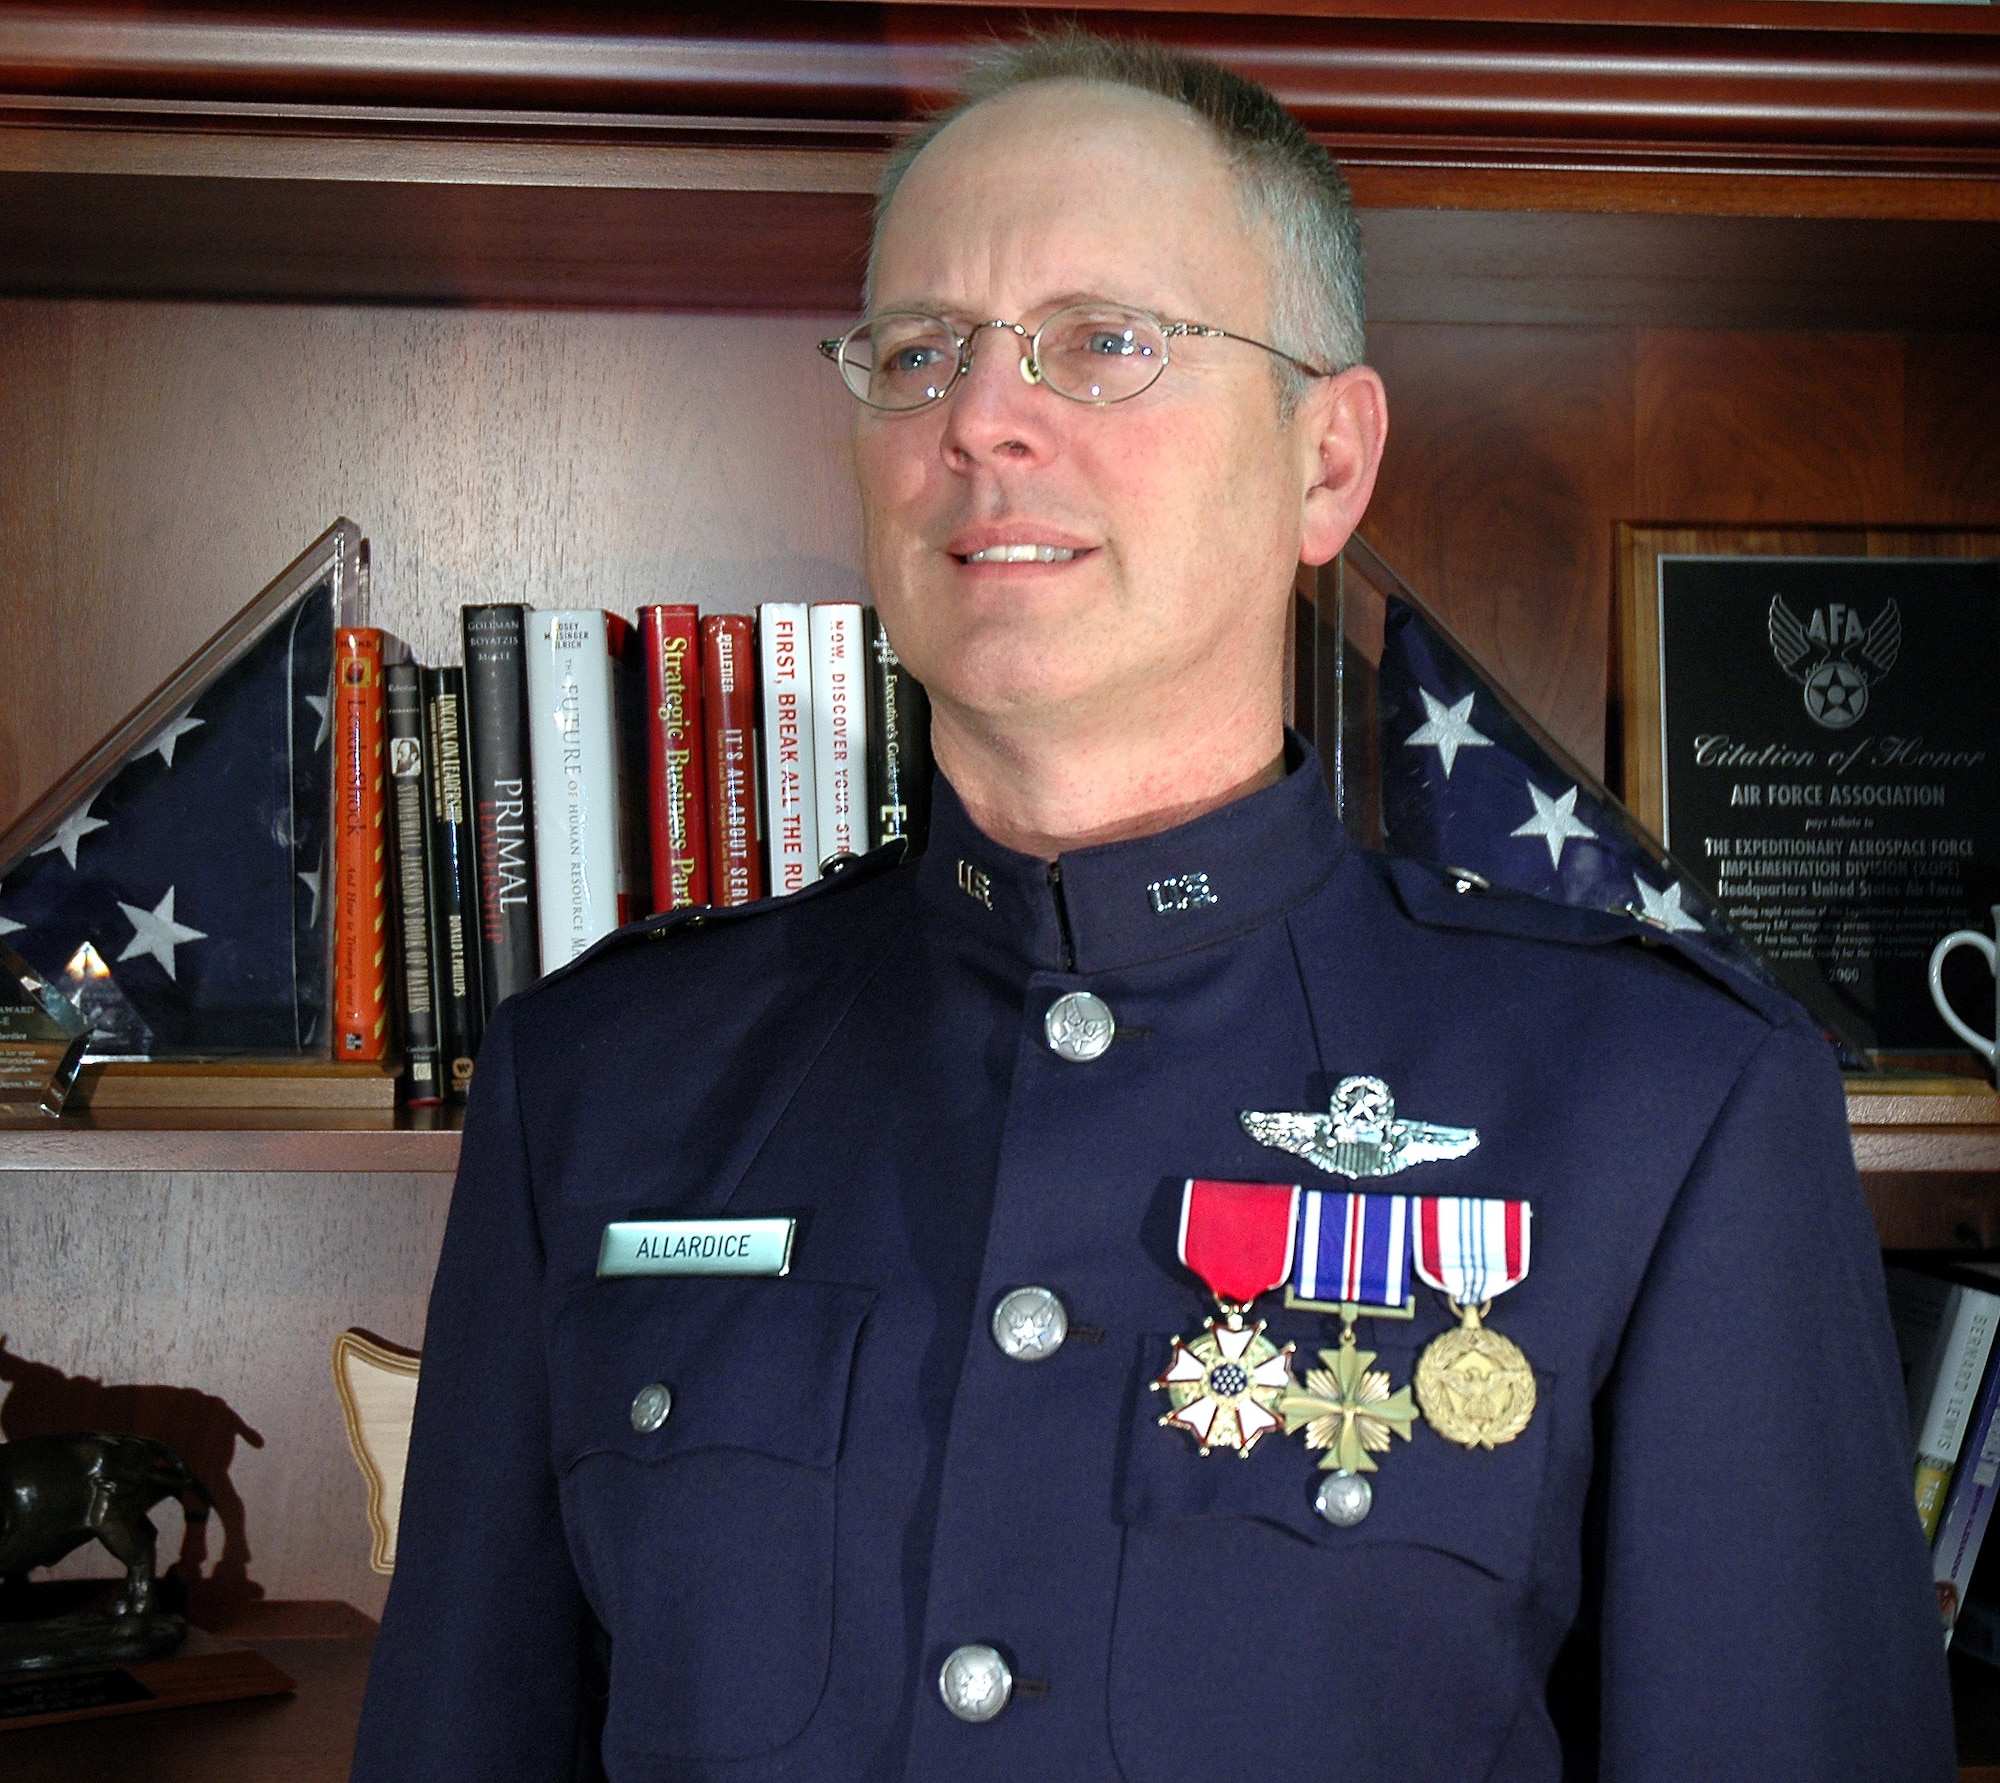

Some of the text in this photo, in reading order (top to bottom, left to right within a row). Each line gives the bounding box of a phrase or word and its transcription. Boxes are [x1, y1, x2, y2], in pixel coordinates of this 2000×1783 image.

[556, 623, 579, 631] OSEY
[830, 620, 845, 664] NOW,
[1808, 603, 1864, 645] AFA
[774, 621, 795, 684] FIRST,
[658, 637, 691, 740] Strategic
[562, 685, 582, 774] FUTURE
[778, 693, 799, 763] BREAK
[832, 673, 848, 761] DISCOVER
[438, 694, 464, 824] LINCOLN ON LEADERSHIP
[726, 729, 744, 760] IT'S
[1694, 734, 1986, 776] Citation of Honor
[348, 700, 368, 837] LeaderShock
[568, 780, 578, 798] OF
[728, 770, 744, 797] ALL
[781, 770, 800, 808] ALL
[666, 748, 692, 850] Business
[834, 768, 849, 815] YOUR
[1730, 784, 1946, 807] AIR FORCE ASSOCIATION
[494, 778, 528, 913] PRIMAL
[568, 805, 581, 856] HUMAN
[729, 806, 747, 858] ABOUT
[783, 813, 802, 854] THE
[1704, 837, 1974, 857] THE EXPEDITIONARY AEROSPACE FORCE
[479, 802, 505, 945] LEADERSHIP
[1718, 879, 1807, 900] Headquarters
[1811, 880, 1855, 898] United
[1859, 880, 1900, 898] States
[1929, 881, 1964, 898] Force
[1720, 859, 1841, 878] IMPLEMENTATION
[1846, 860, 1908, 878] DIVISION
[398, 784, 431, 1014] STONEWALL JACKSON'S BOOK OF MAXIMS
[571, 862, 584, 931] RESOURCE
[345, 936, 357, 980] Triumph
[636, 1234, 752, 1258] ALLARDICE
